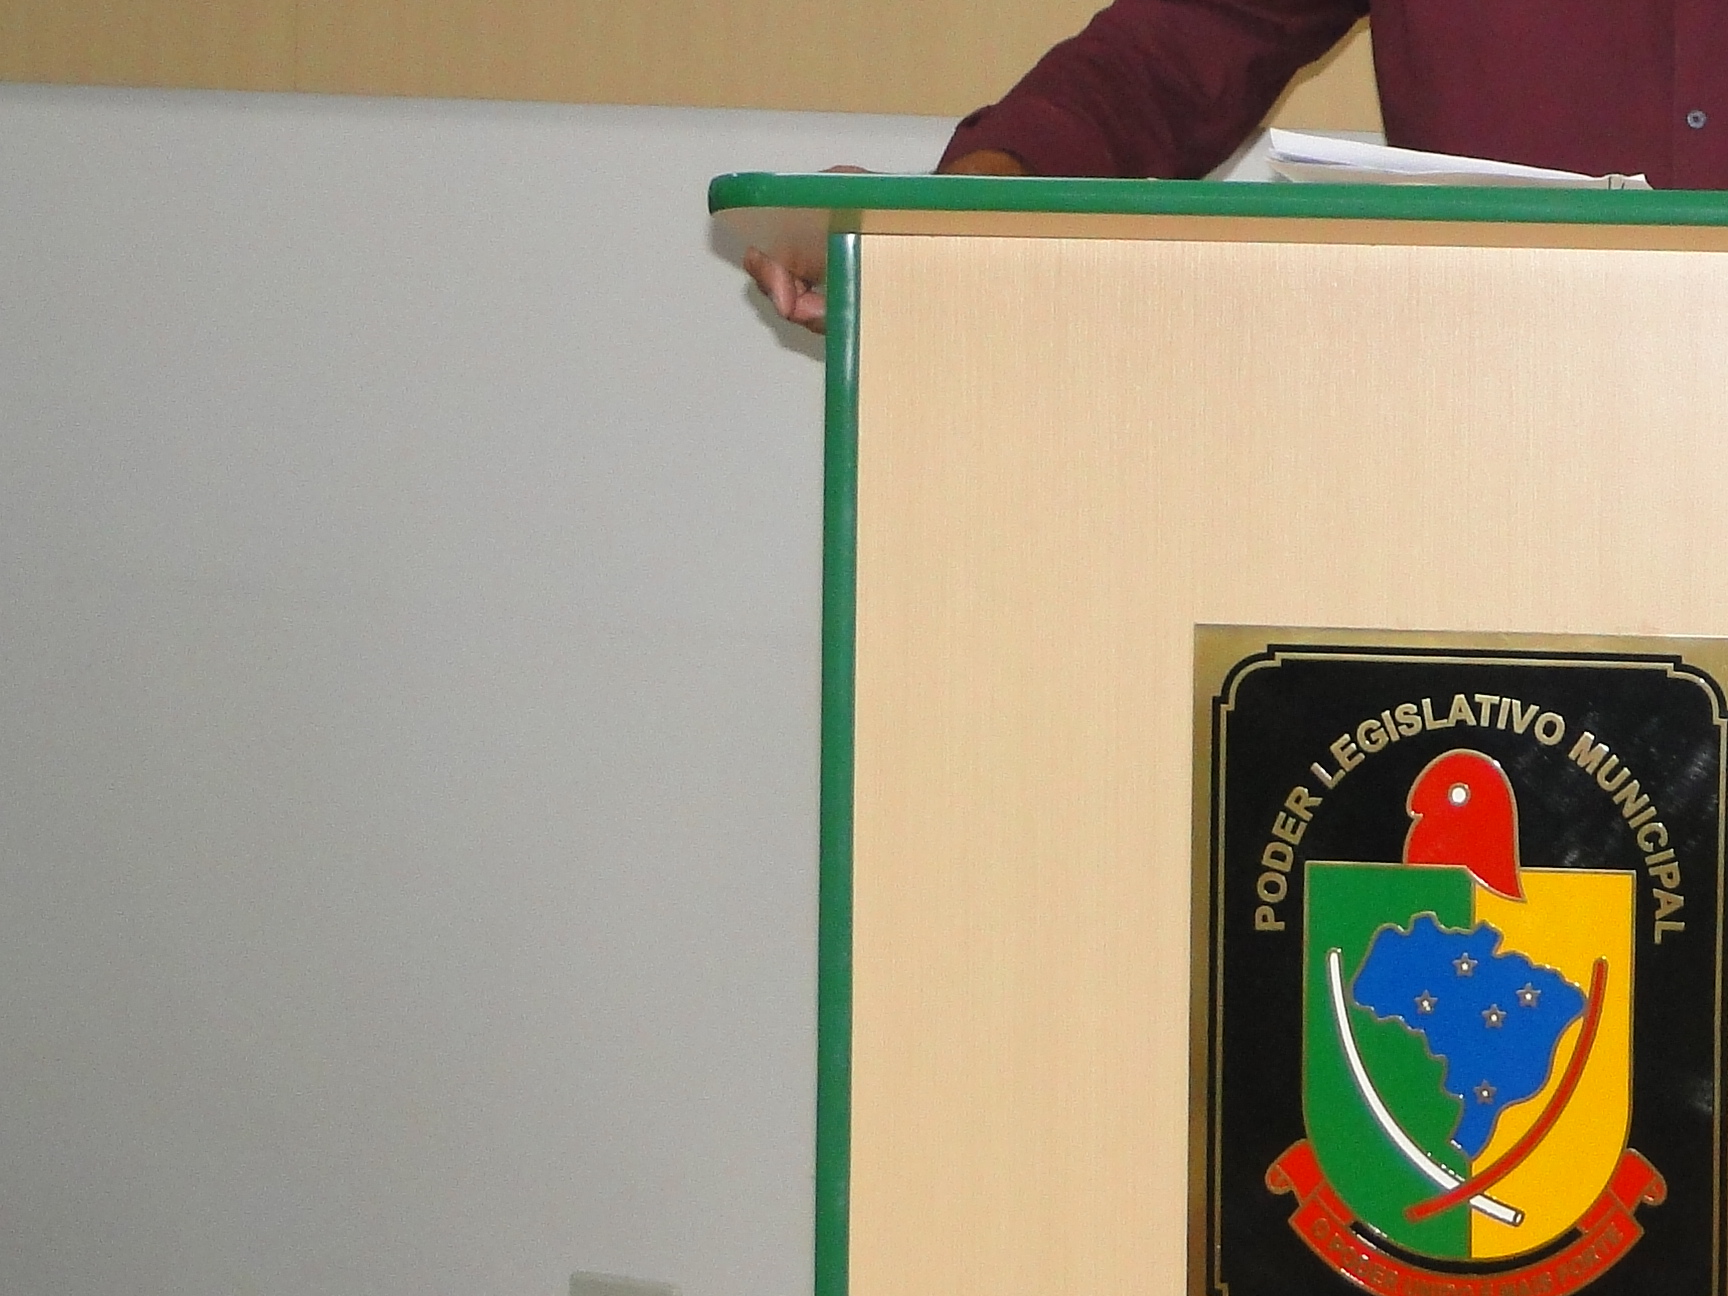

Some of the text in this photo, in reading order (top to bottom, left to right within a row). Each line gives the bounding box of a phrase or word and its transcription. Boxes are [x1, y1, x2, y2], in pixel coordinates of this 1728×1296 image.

[1255, 694, 1686, 946] PODER LEGISLATIVO MUNICIPAL
